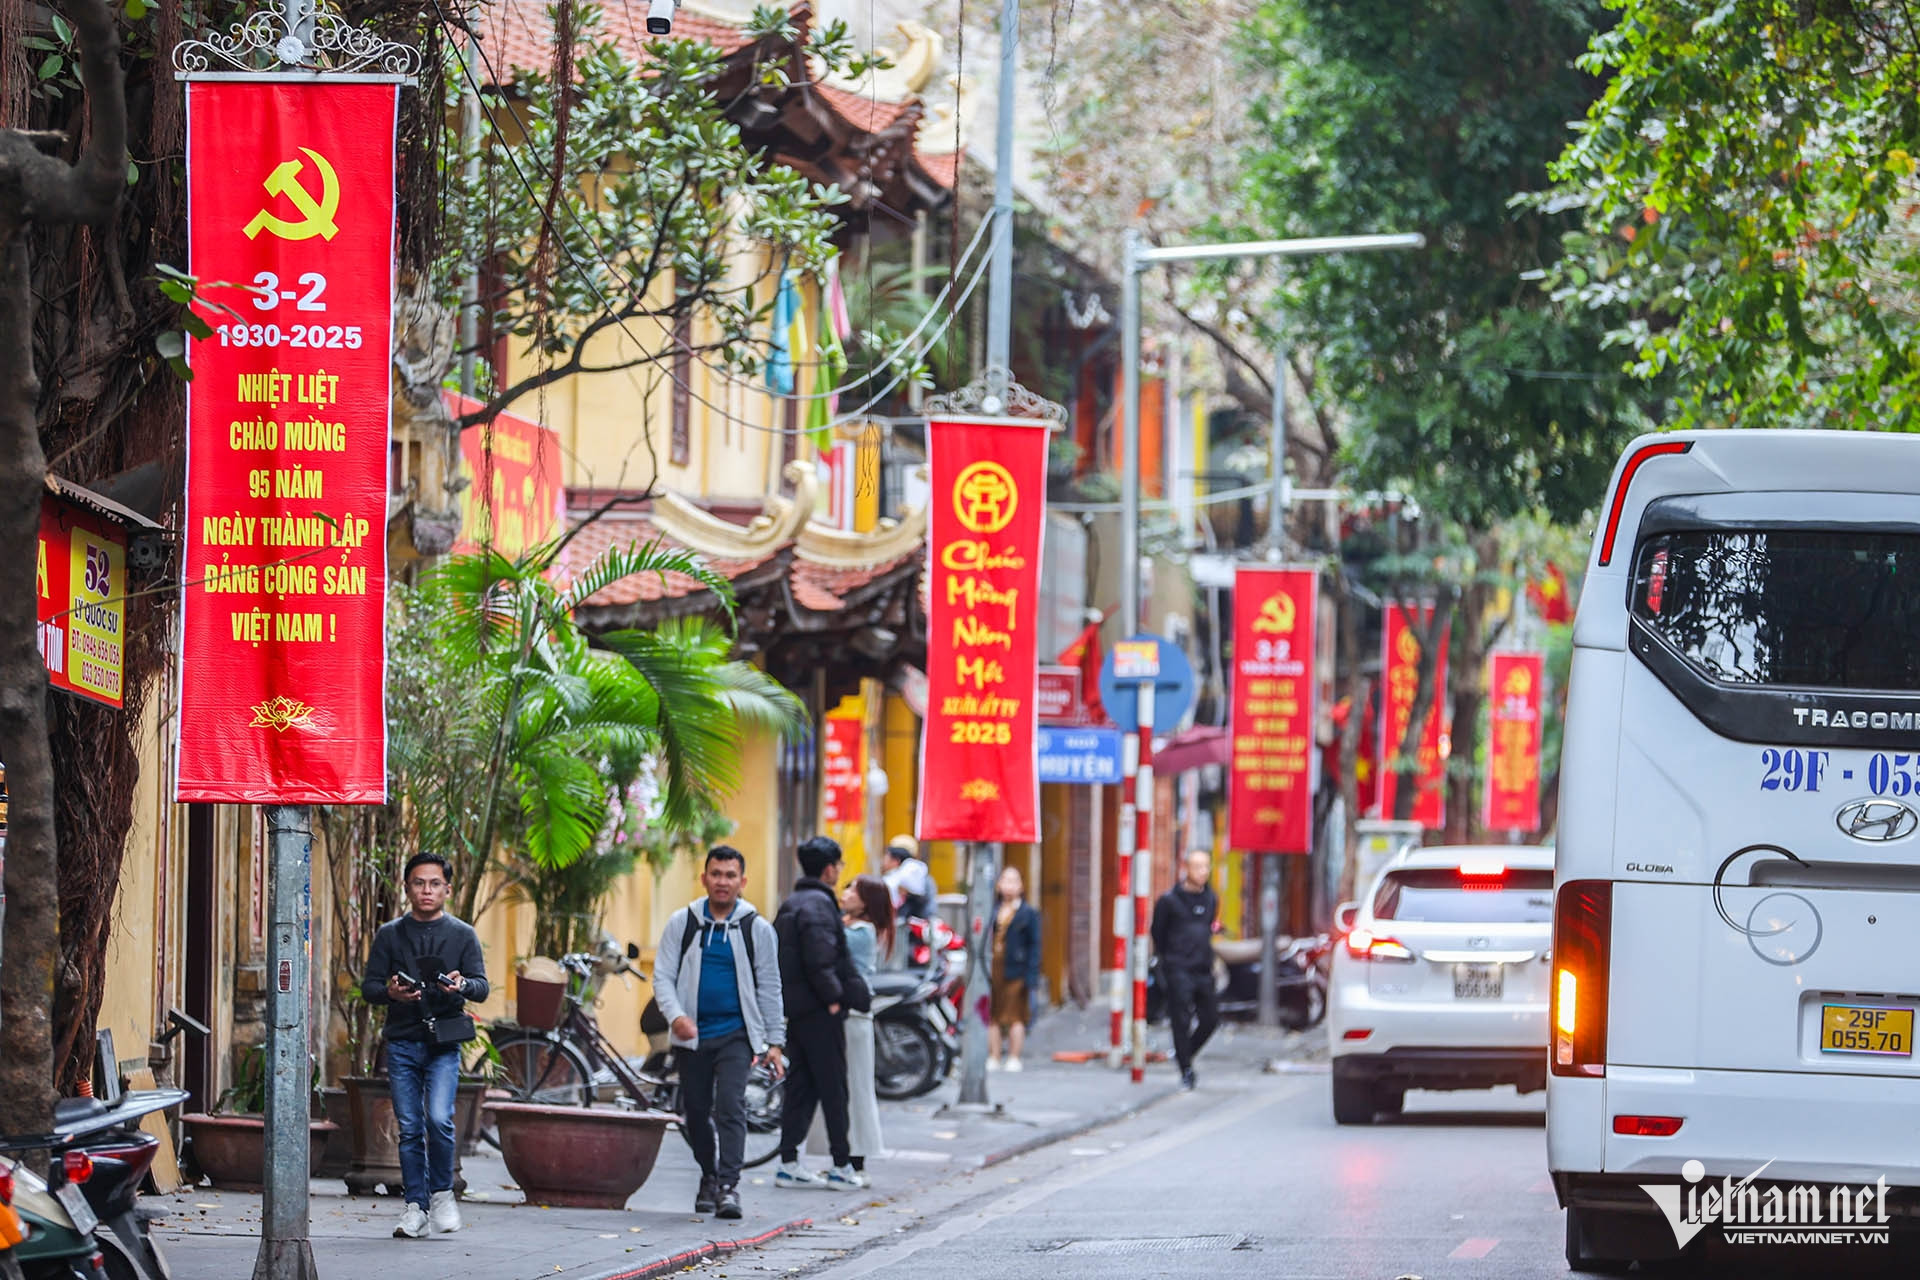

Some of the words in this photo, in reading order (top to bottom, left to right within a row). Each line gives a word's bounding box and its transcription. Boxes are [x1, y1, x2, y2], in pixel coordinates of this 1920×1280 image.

[252, 271, 327, 312] 3-2
[216, 324, 362, 349] 1930-2025
[238, 368, 292, 409] NHIỆT
[297, 369, 339, 410] LIỆT
[229, 415, 278, 450] CHÀO
[284, 415, 346, 452] MỪNG
[249, 470, 270, 498] 95
[275, 463, 323, 498] NĂM
[203, 511, 256, 546] NGÀY
[260, 511, 324, 547] THÀNH
[330, 512, 369, 554] LẬP
[85, 542, 110, 598] 52
[204, 552, 259, 593] ĐẢNG
[264, 559, 317, 600] CỘNG
[323, 554, 366, 595] SẢN
[231, 606, 271, 648] VIỆT
[275, 613, 323, 642] NAM
[951, 721, 1011, 744] 2025
[1761, 748, 1829, 792] 29F
[1849, 1010, 1887, 1029] 29F
[1831, 1030, 1902, 1051] 055.70
